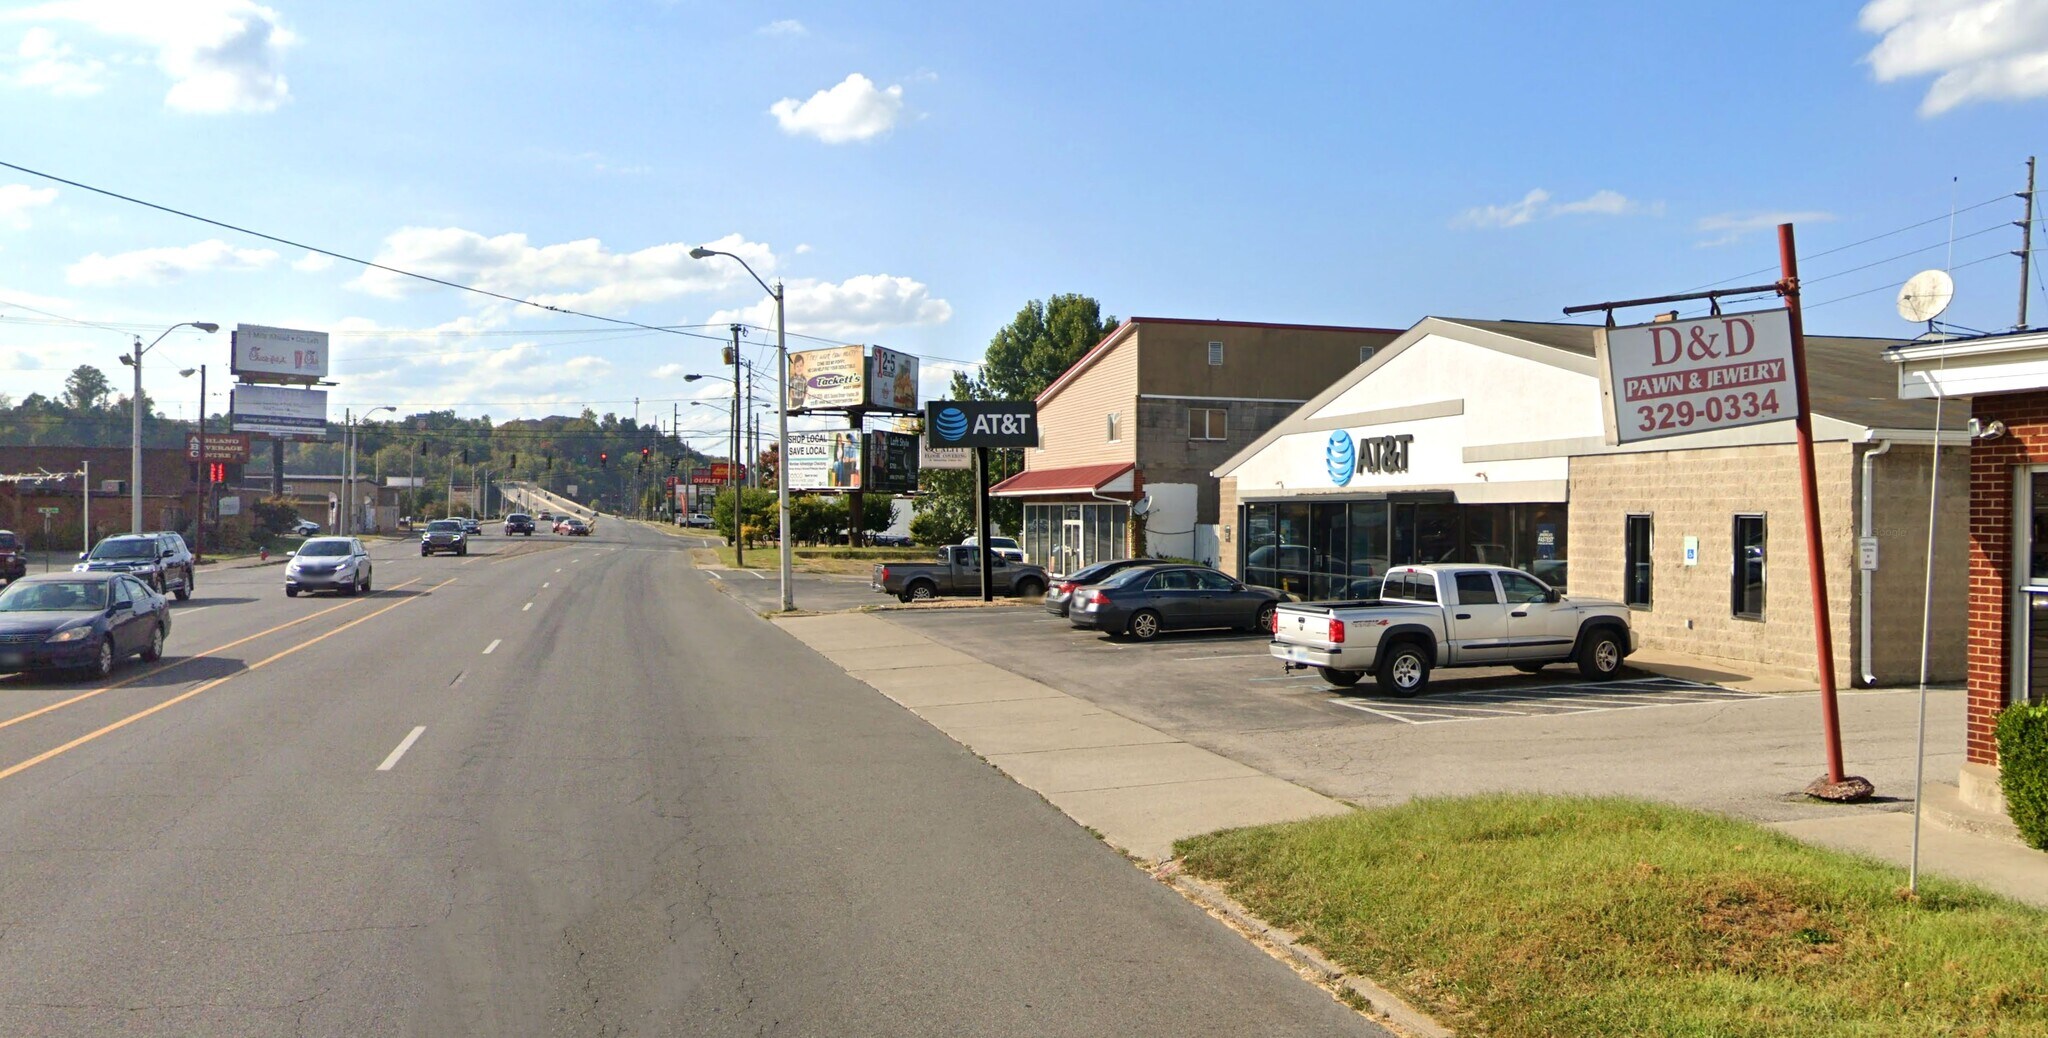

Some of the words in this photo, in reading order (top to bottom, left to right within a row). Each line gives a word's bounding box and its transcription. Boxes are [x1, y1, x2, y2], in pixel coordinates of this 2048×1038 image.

[1648, 318, 1755, 367] D&D
[817, 373, 860, 386] Tackett's
[1626, 374, 1684, 398] PAWN
[1688, 372, 1702, 390] &
[1707, 362, 1783, 389] JEWELRY
[972, 414, 1031, 435] AT&T
[1637, 389, 1779, 432] 329-0334
[788, 435, 805, 444] SHOP
[807, 434, 828, 443] LOCAL
[789, 447, 804, 455] SAVE
[806, 446, 827, 455] LOCAL
[1356, 434, 1414, 475] AT&T
